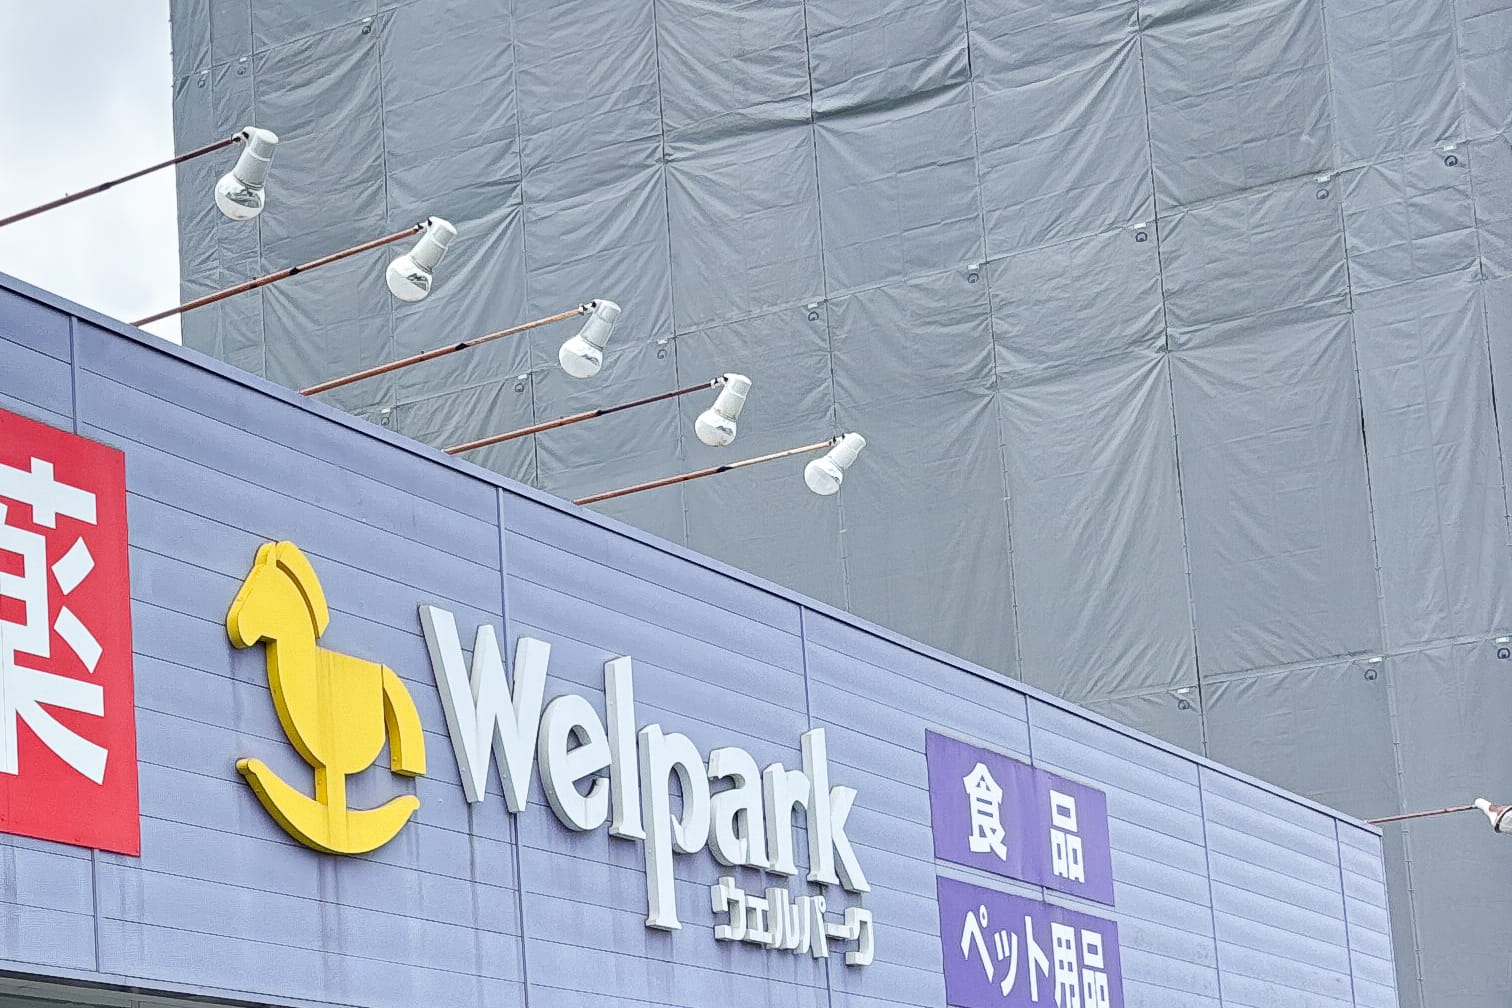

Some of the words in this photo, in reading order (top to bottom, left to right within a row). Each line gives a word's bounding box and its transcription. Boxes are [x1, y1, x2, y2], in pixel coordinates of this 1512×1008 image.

[418, 604, 871, 931] Welpark
[962, 761, 1086, 884] 食品
[710, 876, 875, 966] ウェルパーク
